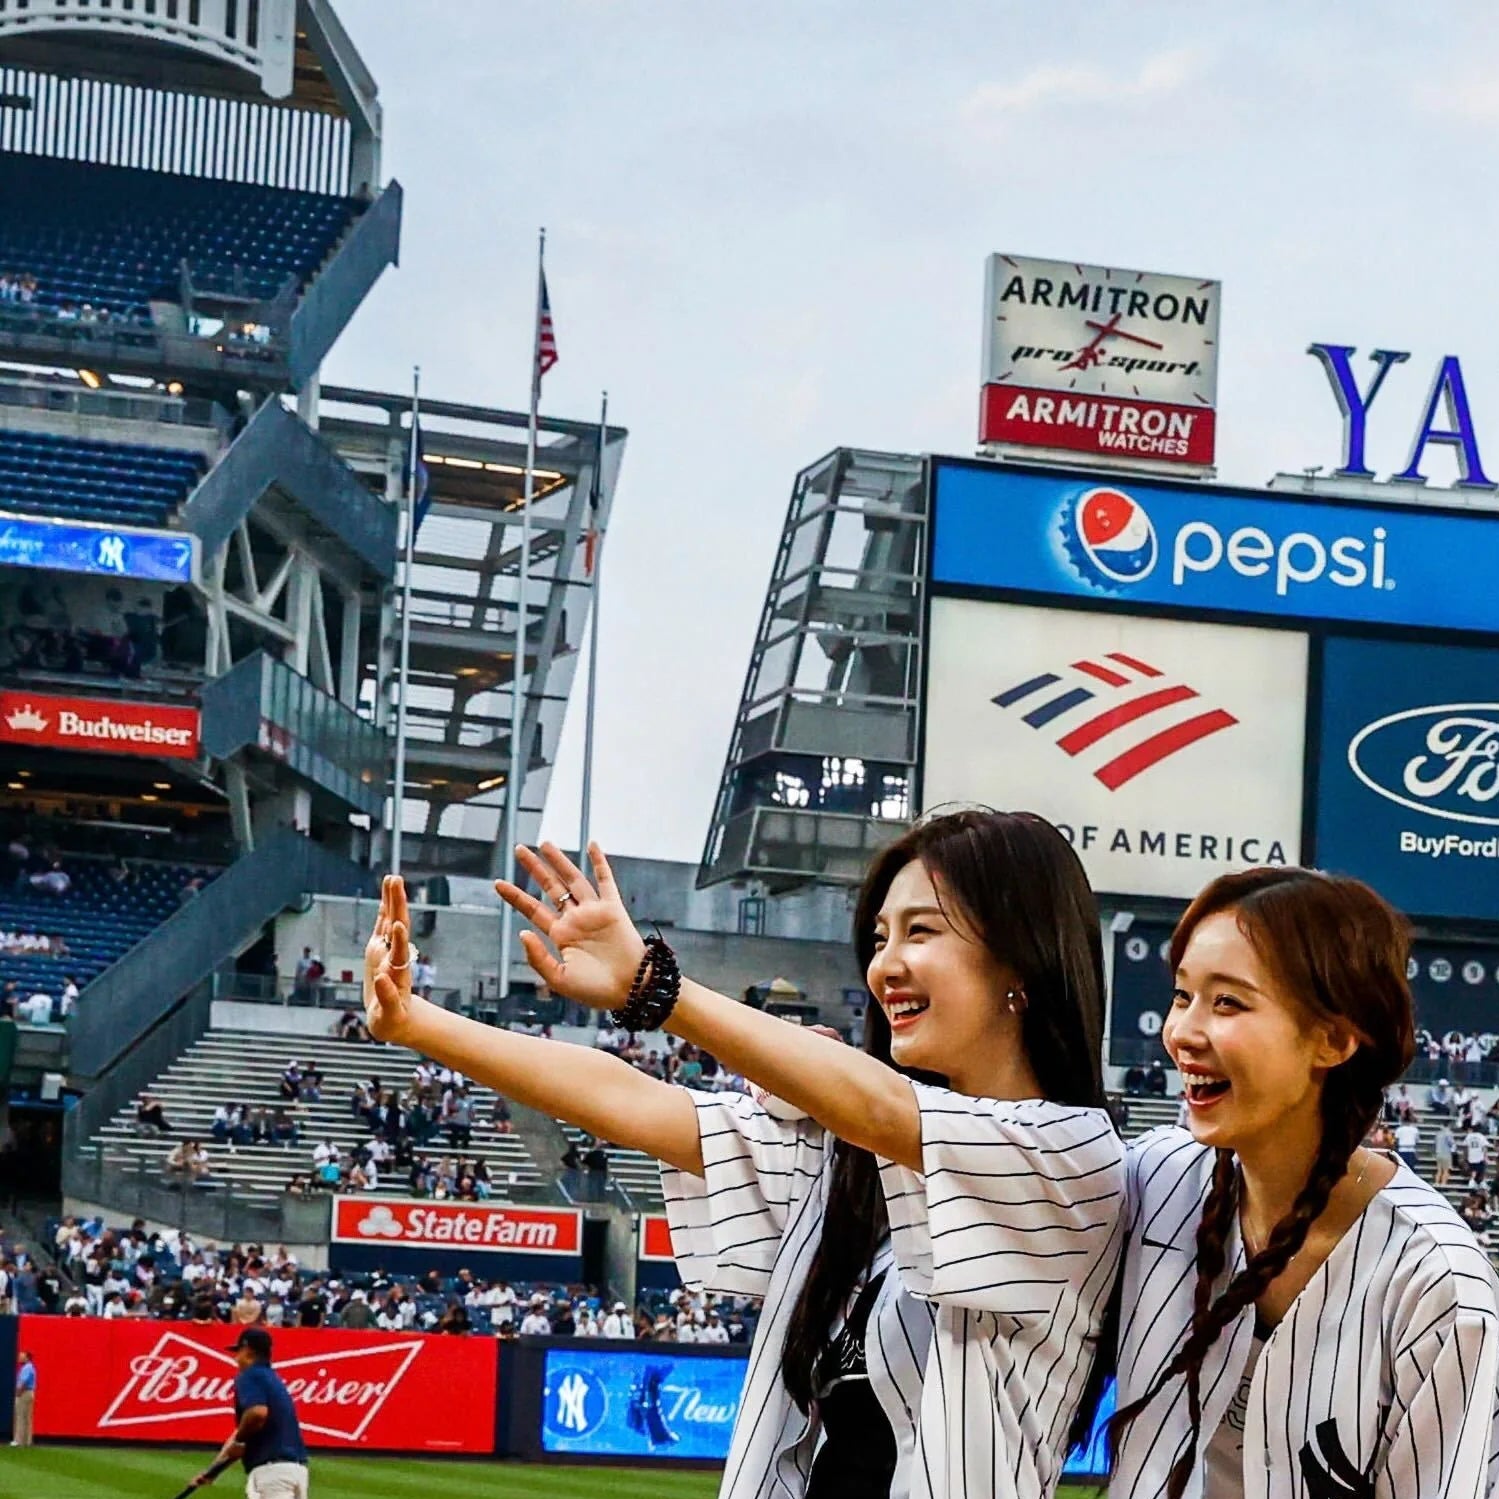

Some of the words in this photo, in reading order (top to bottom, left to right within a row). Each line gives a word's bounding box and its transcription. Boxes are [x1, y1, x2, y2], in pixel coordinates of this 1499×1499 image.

[1001, 276, 1209, 325] ARMITRON
[1011, 346, 1073, 362] pro
[1108, 355, 1200, 375] sport
[1006, 395, 1193, 438] ARMITRON
[1099, 431, 1188, 455] WATCHES
[1173, 527, 1386, 595] pepsi
[58, 711, 193, 746] Budweiser
[1110, 828, 1287, 865] AMERICA
[131, 1355, 389, 1406] Bueiser
